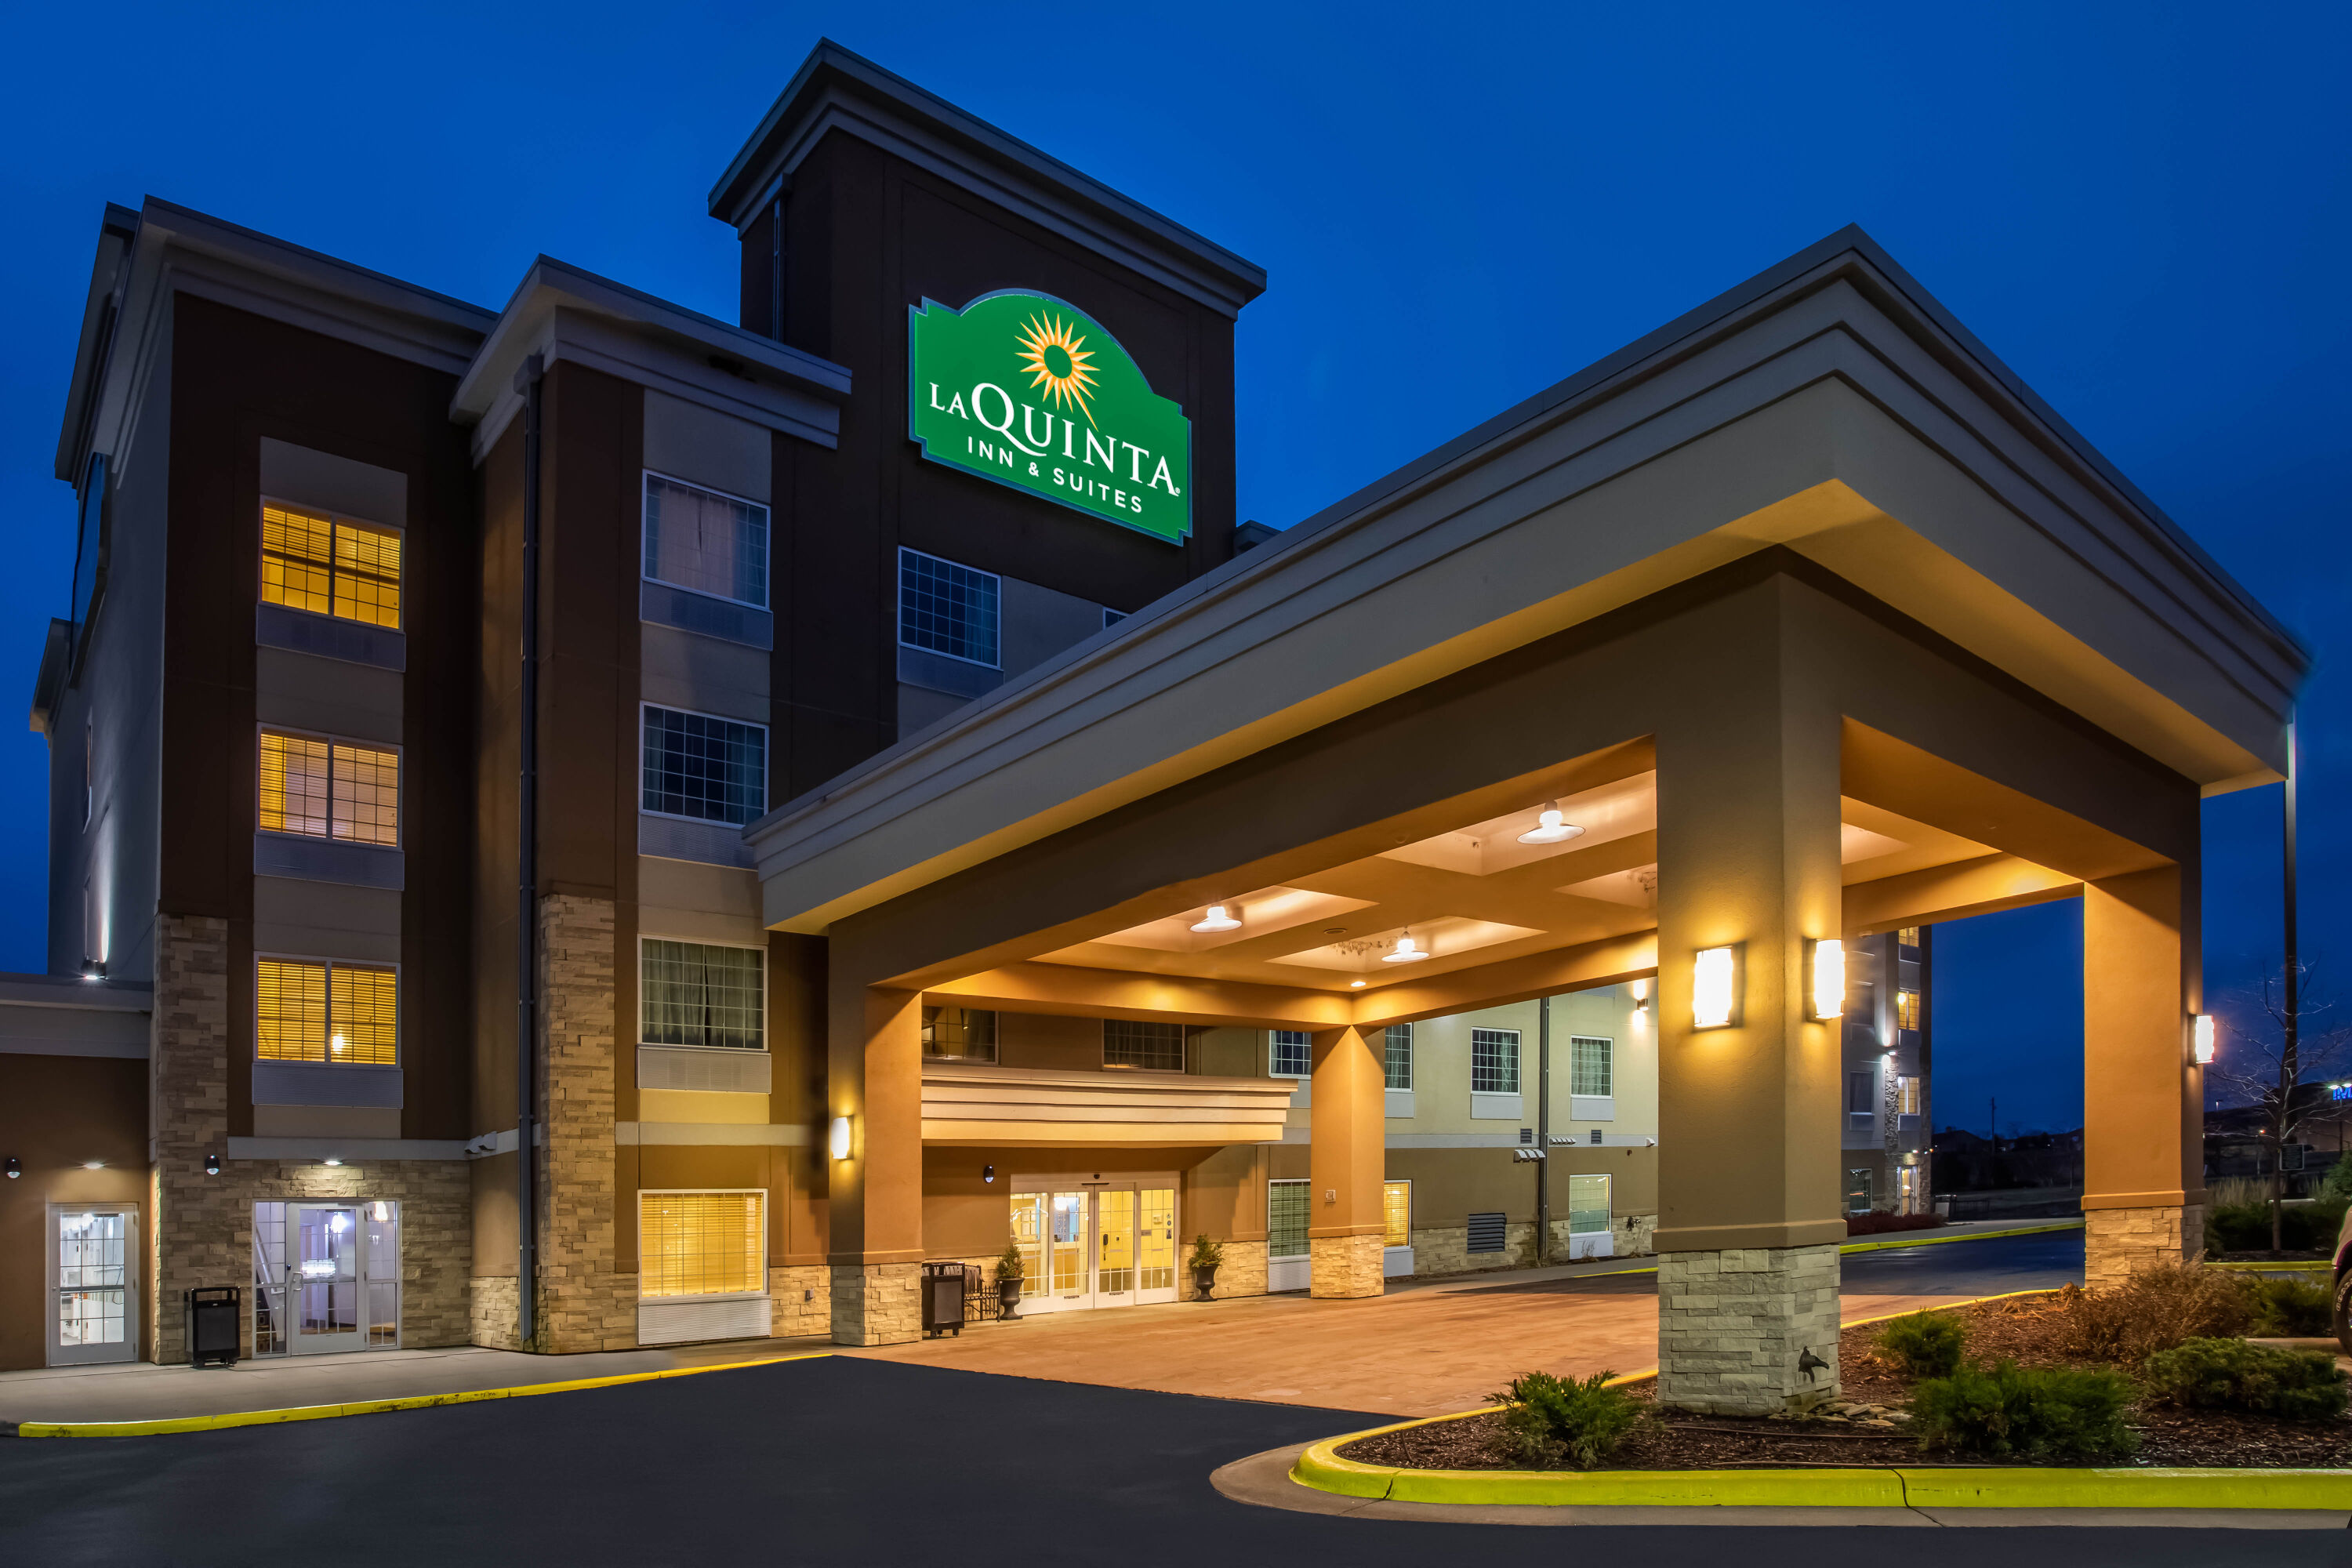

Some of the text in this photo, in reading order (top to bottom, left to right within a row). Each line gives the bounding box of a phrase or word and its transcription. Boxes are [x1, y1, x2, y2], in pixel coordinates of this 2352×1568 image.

[929, 382, 1179, 497] LA QUINTA
[968, 436, 1142, 514] INN & SUITES
